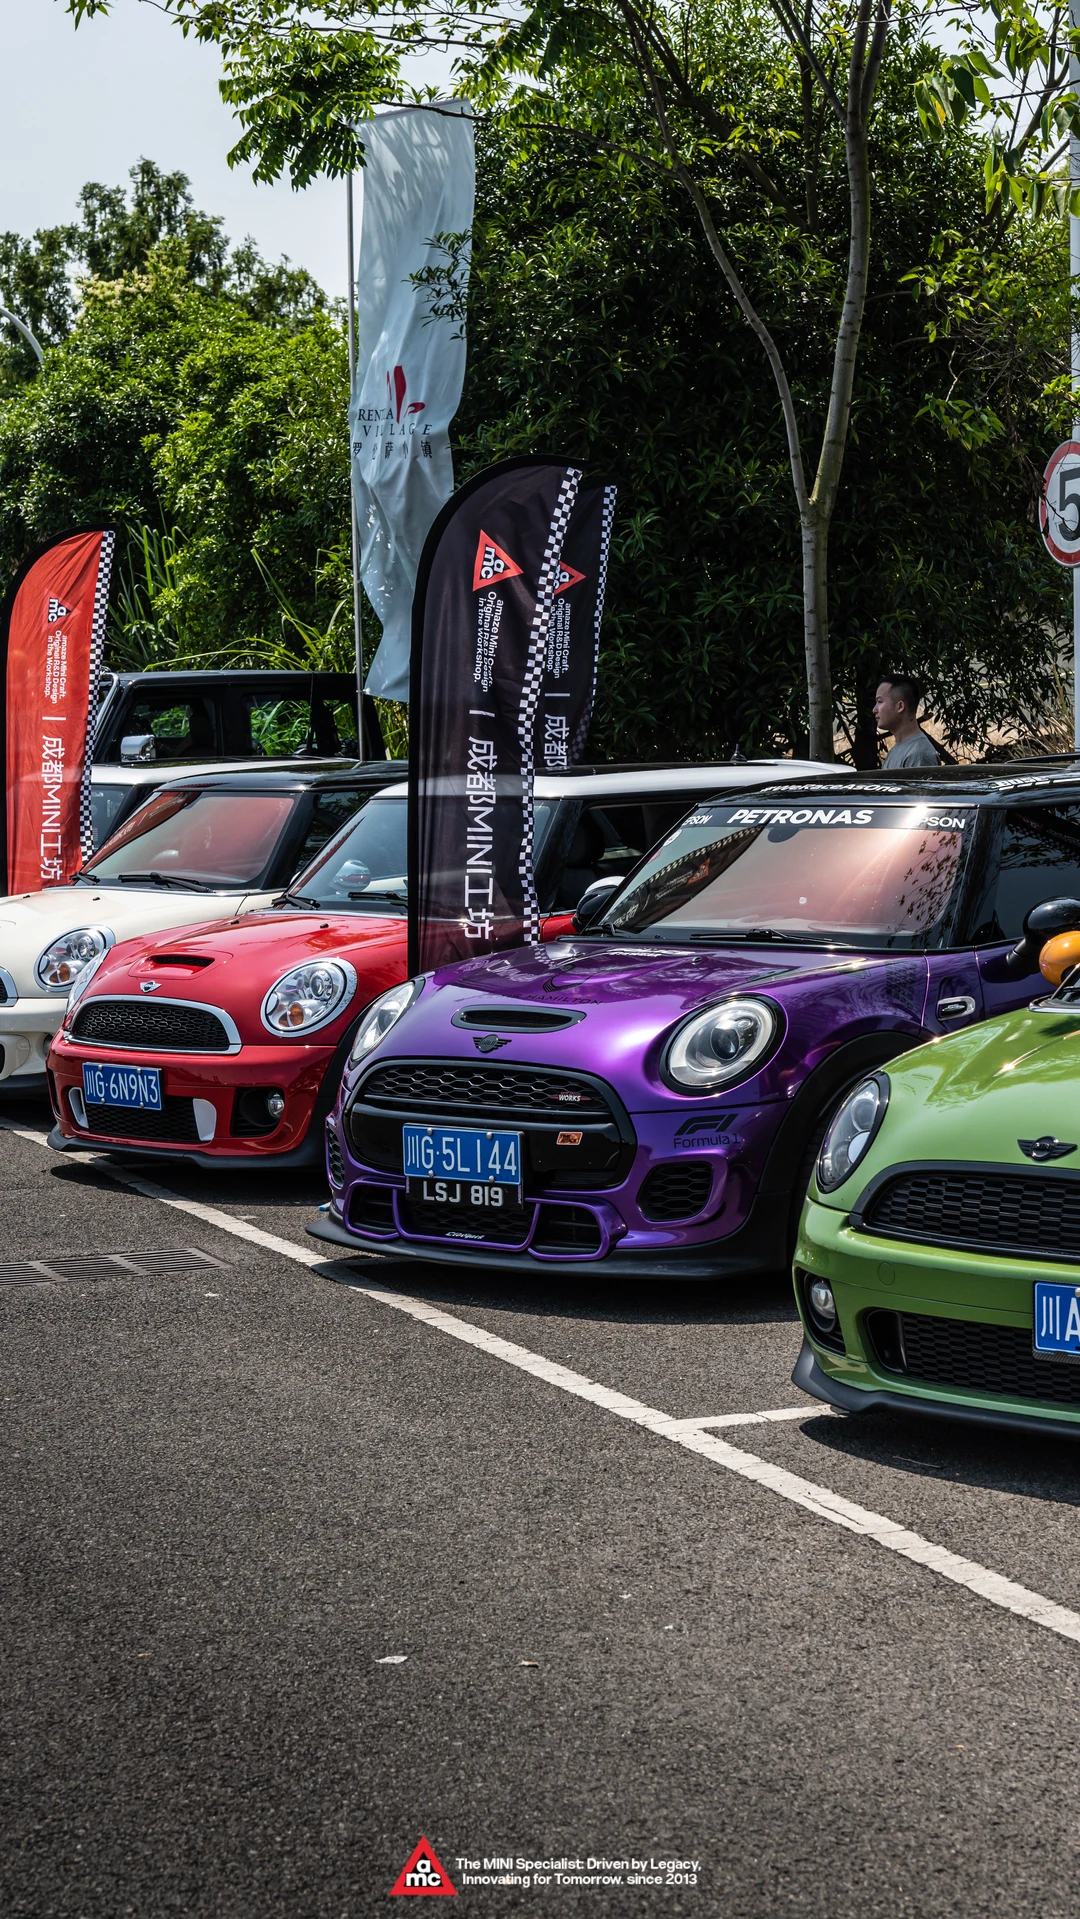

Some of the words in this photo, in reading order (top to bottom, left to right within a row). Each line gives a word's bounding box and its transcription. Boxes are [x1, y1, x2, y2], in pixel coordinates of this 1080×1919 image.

[478, 598, 486, 607] in
[483, 591, 496, 628] Original
[492, 600, 504, 633] amaze
[556, 598, 565, 629] Original
[53, 630, 61, 659] Original
[488, 634, 498, 657] Mini
[547, 628, 556, 672] Workshop.
[44, 657, 53, 697] Workshop.
[553, 651, 562, 678] Design
[51, 677, 59, 704] Design
[40, 735, 65, 880] 成都MINI工坊
[727, 809, 874, 824] PETRONAS
[464, 736, 498, 940] 成都MINI工坊
[526, 994, 603, 1005] HAMILTON
[673, 1135, 730, 1149] Formula
[732, 1134, 740, 1144] 1
[423, 1181, 461, 1203] LSJ
[470, 1185, 503, 1206] 819
